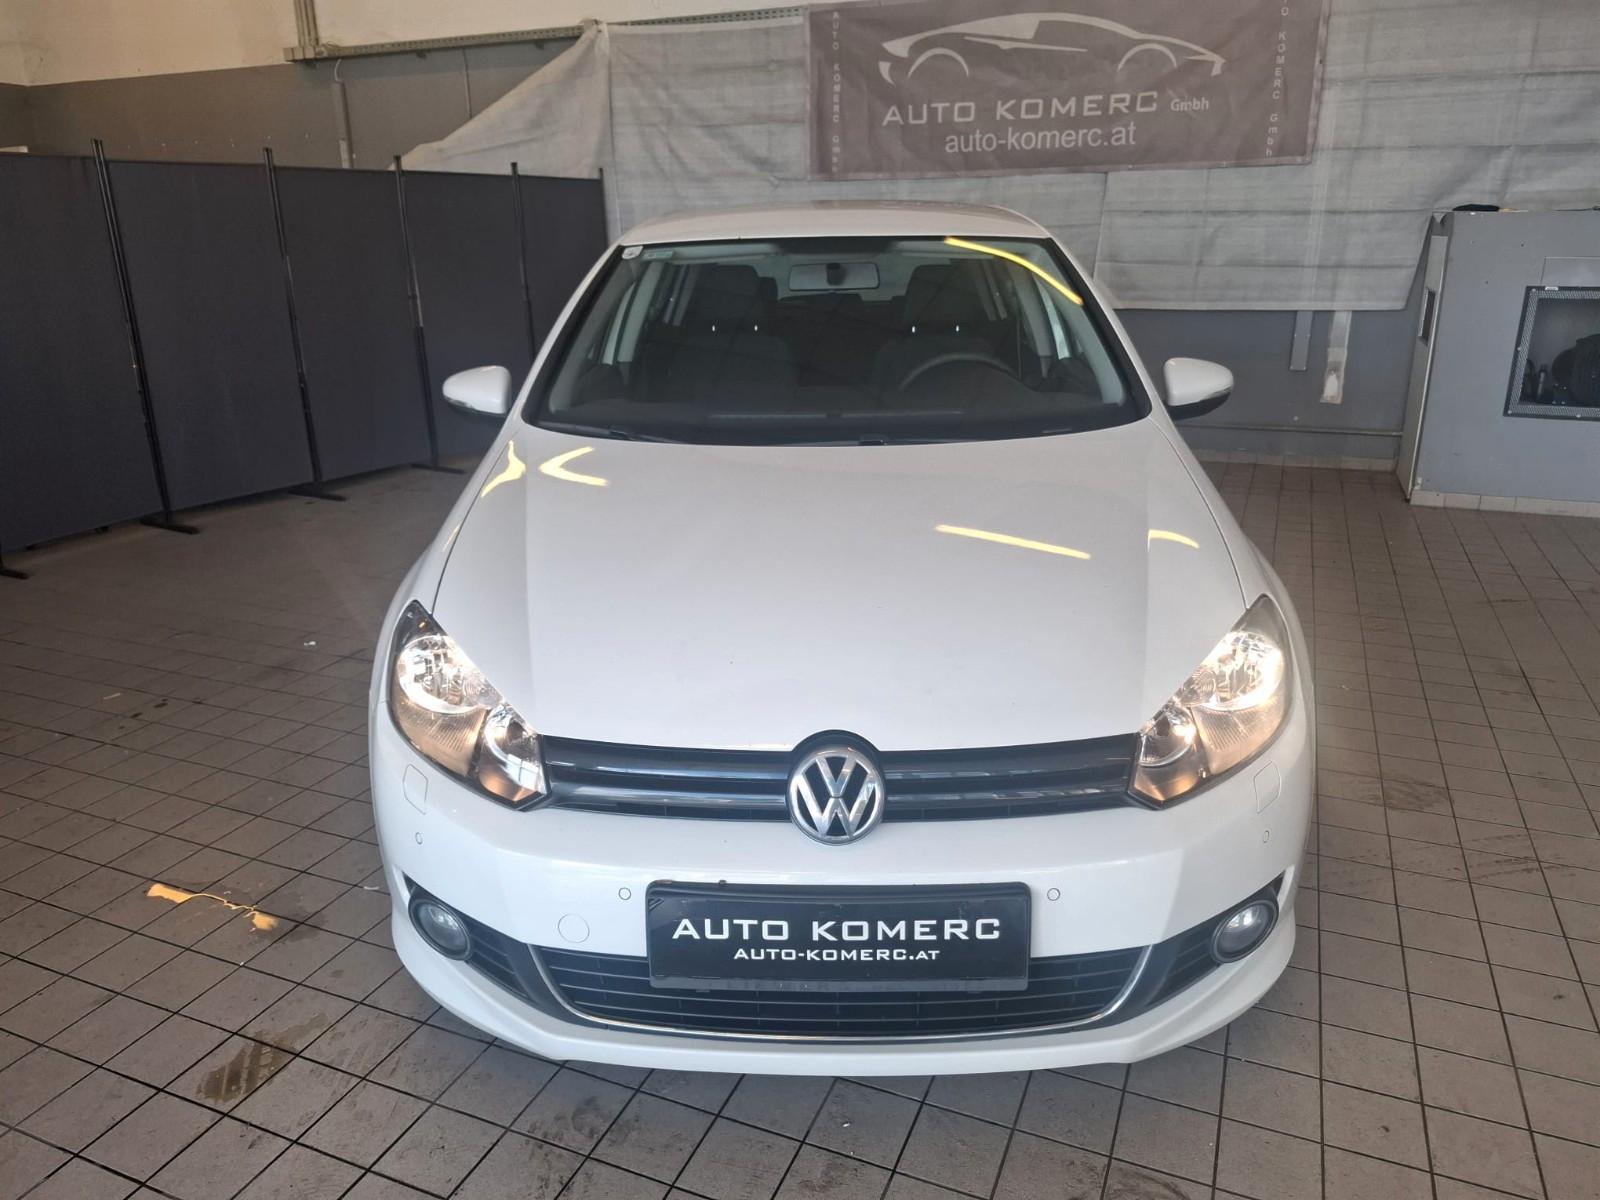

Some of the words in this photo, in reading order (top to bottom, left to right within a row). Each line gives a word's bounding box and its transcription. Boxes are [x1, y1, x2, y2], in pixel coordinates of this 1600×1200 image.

[1272, 31, 1287, 100] KOMERC
[881, 101, 975, 126] AUTO
[996, 91, 1159, 120] KOMERC
[1170, 97, 1210, 112] Gmbh
[944, 121, 1137, 154] auto-komerc.at
[672, 918, 789, 941] AUTO
[812, 918, 1001, 942] KOMERC
[734, 948, 940, 961] AUTO-KOMERC.AT
